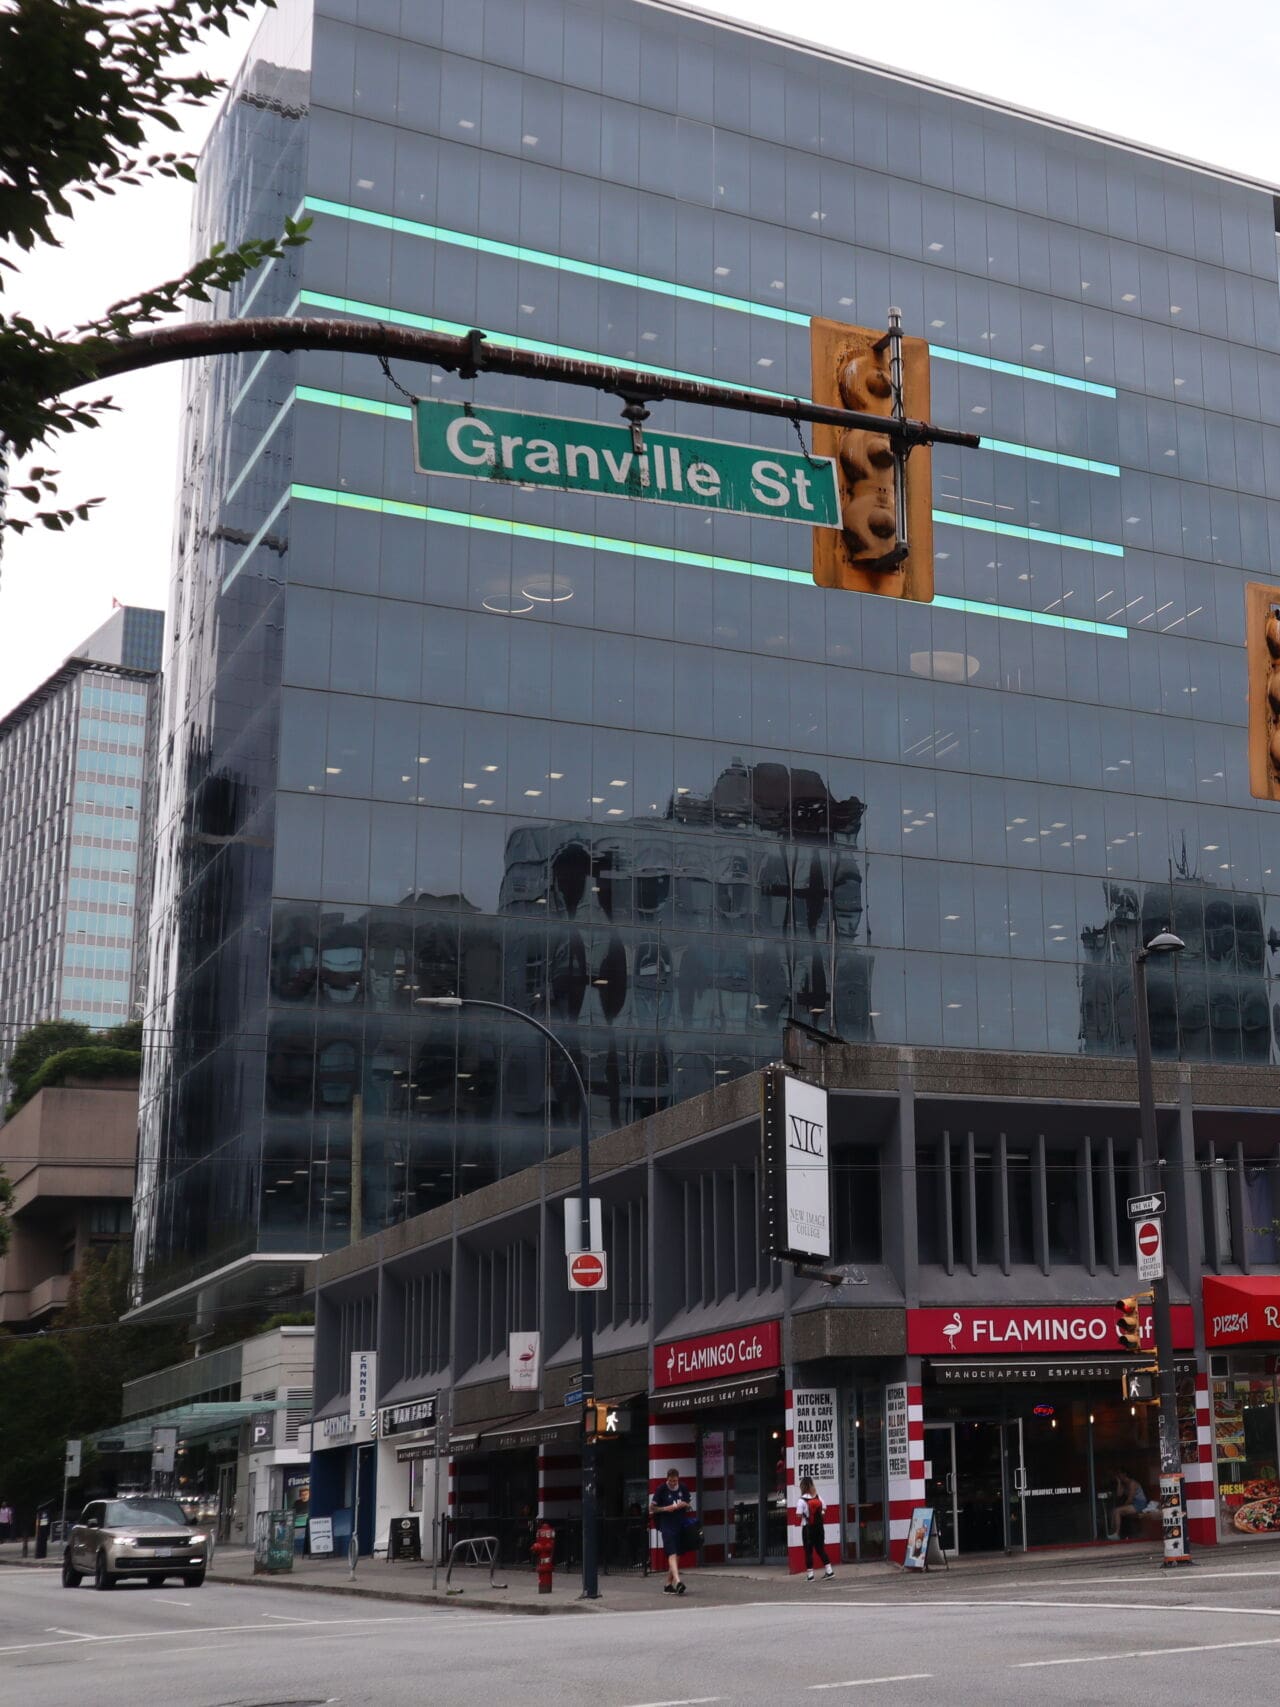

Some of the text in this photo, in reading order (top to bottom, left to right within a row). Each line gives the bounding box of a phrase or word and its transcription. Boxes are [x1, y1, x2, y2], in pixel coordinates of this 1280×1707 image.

[445, 415, 815, 511] Granville St
[788, 1114, 824, 1158] NIC
[1132, 1200, 1153, 1212] ONE WAY
[790, 1208, 825, 1227] NEW IMAGE
[796, 1223, 821, 1239] COLLEGE
[972, 1318, 1107, 1342] FLAMINGO
[1212, 1312, 1249, 1337] PIZZA
[677, 1335, 763, 1374] FLAMINGO Cafe
[945, 1367, 1111, 1379] HANDCRAFTED ESPRESSO
[694, 1395, 714, 1405] LOOSE
[740, 1387, 759, 1396] TEAS
[797, 1393, 833, 1406] KITCHEN,
[797, 1407, 833, 1416] BAR & CAFE
[798, 1419, 833, 1433] ALL DAY
[798, 1433, 833, 1443] BREAKFAST
[798, 1450, 834, 1460] FROM $5.99
[799, 1464, 819, 1477] FREE
[889, 1458, 900, 1471] FREE
[1219, 1483, 1244, 1495] FRESH
